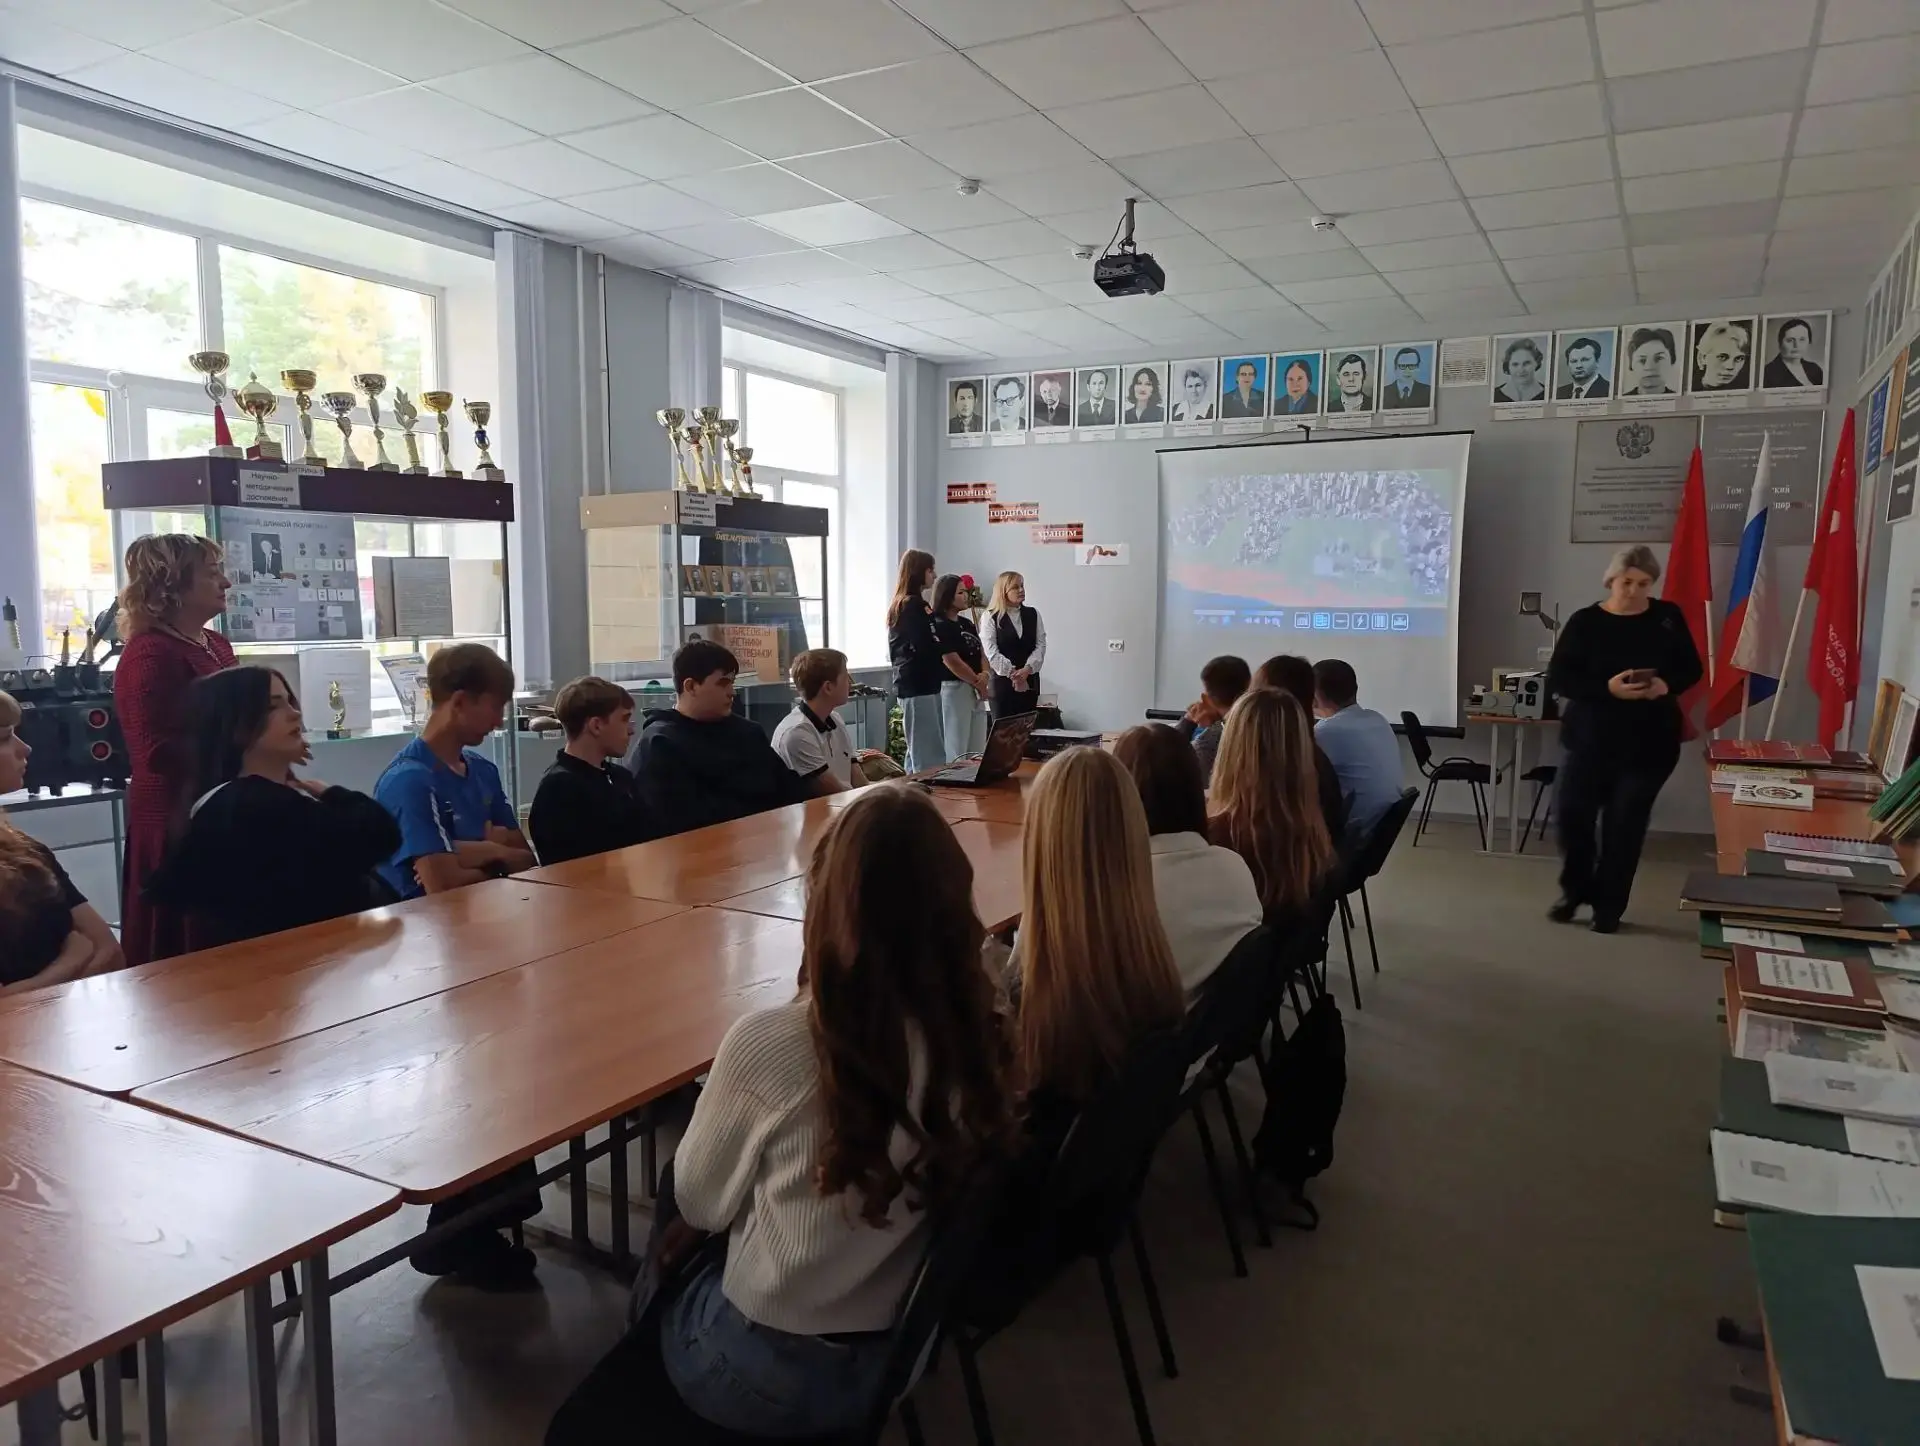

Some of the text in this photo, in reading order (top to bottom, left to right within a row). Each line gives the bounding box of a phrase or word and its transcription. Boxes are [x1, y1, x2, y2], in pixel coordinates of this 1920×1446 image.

[251, 473, 280, 481] Научно-
[951, 489, 992, 497] помним
[989, 508, 1039, 519] гордимся
[1038, 529, 1077, 540] храним
